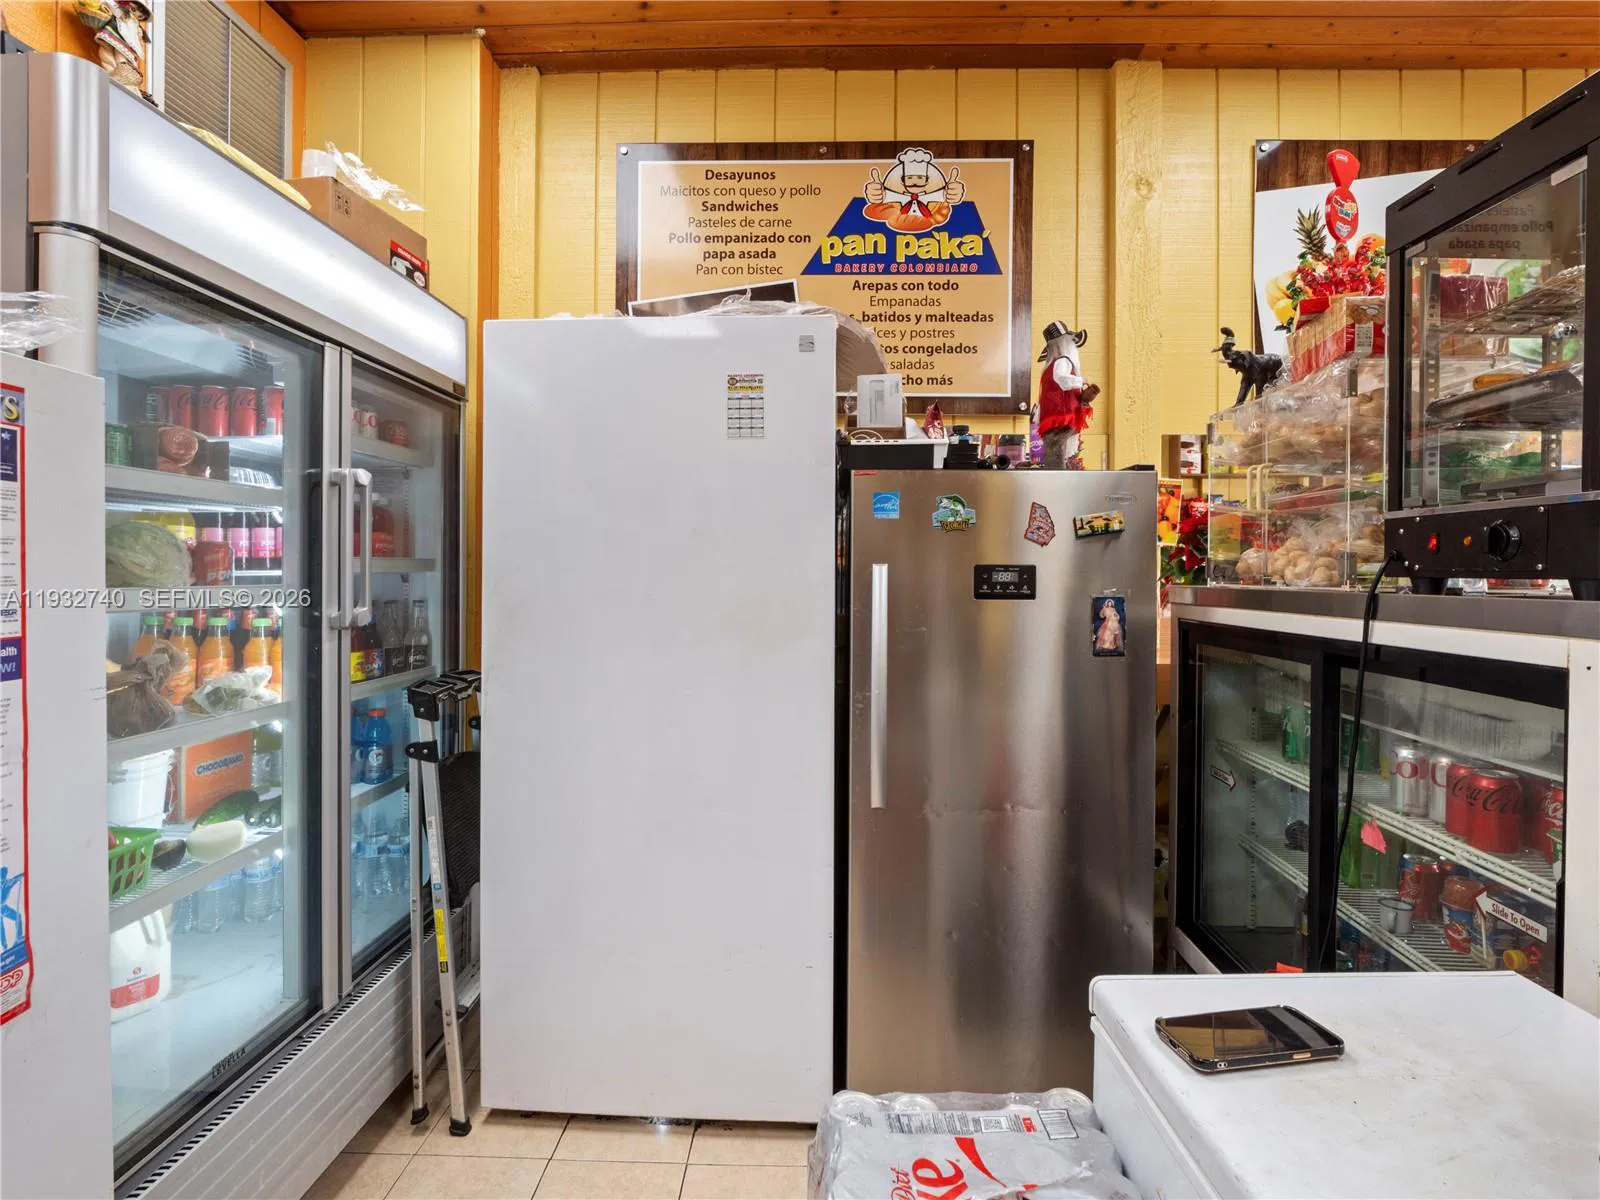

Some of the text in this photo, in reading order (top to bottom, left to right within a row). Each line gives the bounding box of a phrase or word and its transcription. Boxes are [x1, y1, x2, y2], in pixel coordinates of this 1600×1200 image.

[705, 169, 776, 183] Desayunos
[660, 184, 821, 199] Maicitos con queso y pollo
[702, 200, 779, 212] Sandwiches
[688, 216, 792, 228] Pasteles de carne
[669, 232, 812, 246] Pollo empanizado con
[820, 231, 887, 264] pan
[703, 248, 777, 262] papa asada
[696, 263, 784, 275] Pan con bistec
[834, 263, 978, 273] BAKERY COLOMBIANO
[852, 279, 960, 293] Arepas con todo
[869, 296, 942, 309] Empanadas
[862, 311, 912, 323] batidos
[914, 313, 923, 326] y
[925, 311, 994, 323] malteadas
[899, 329, 909, 340] y
[910, 328, 956, 341] postres
[902, 342, 978, 356] congelados
[890, 358, 935, 370] saladas
[926, 374, 954, 386] más
[0, 647, 17, 656] alth
[1491, 903, 1540, 936] Slide To Open
